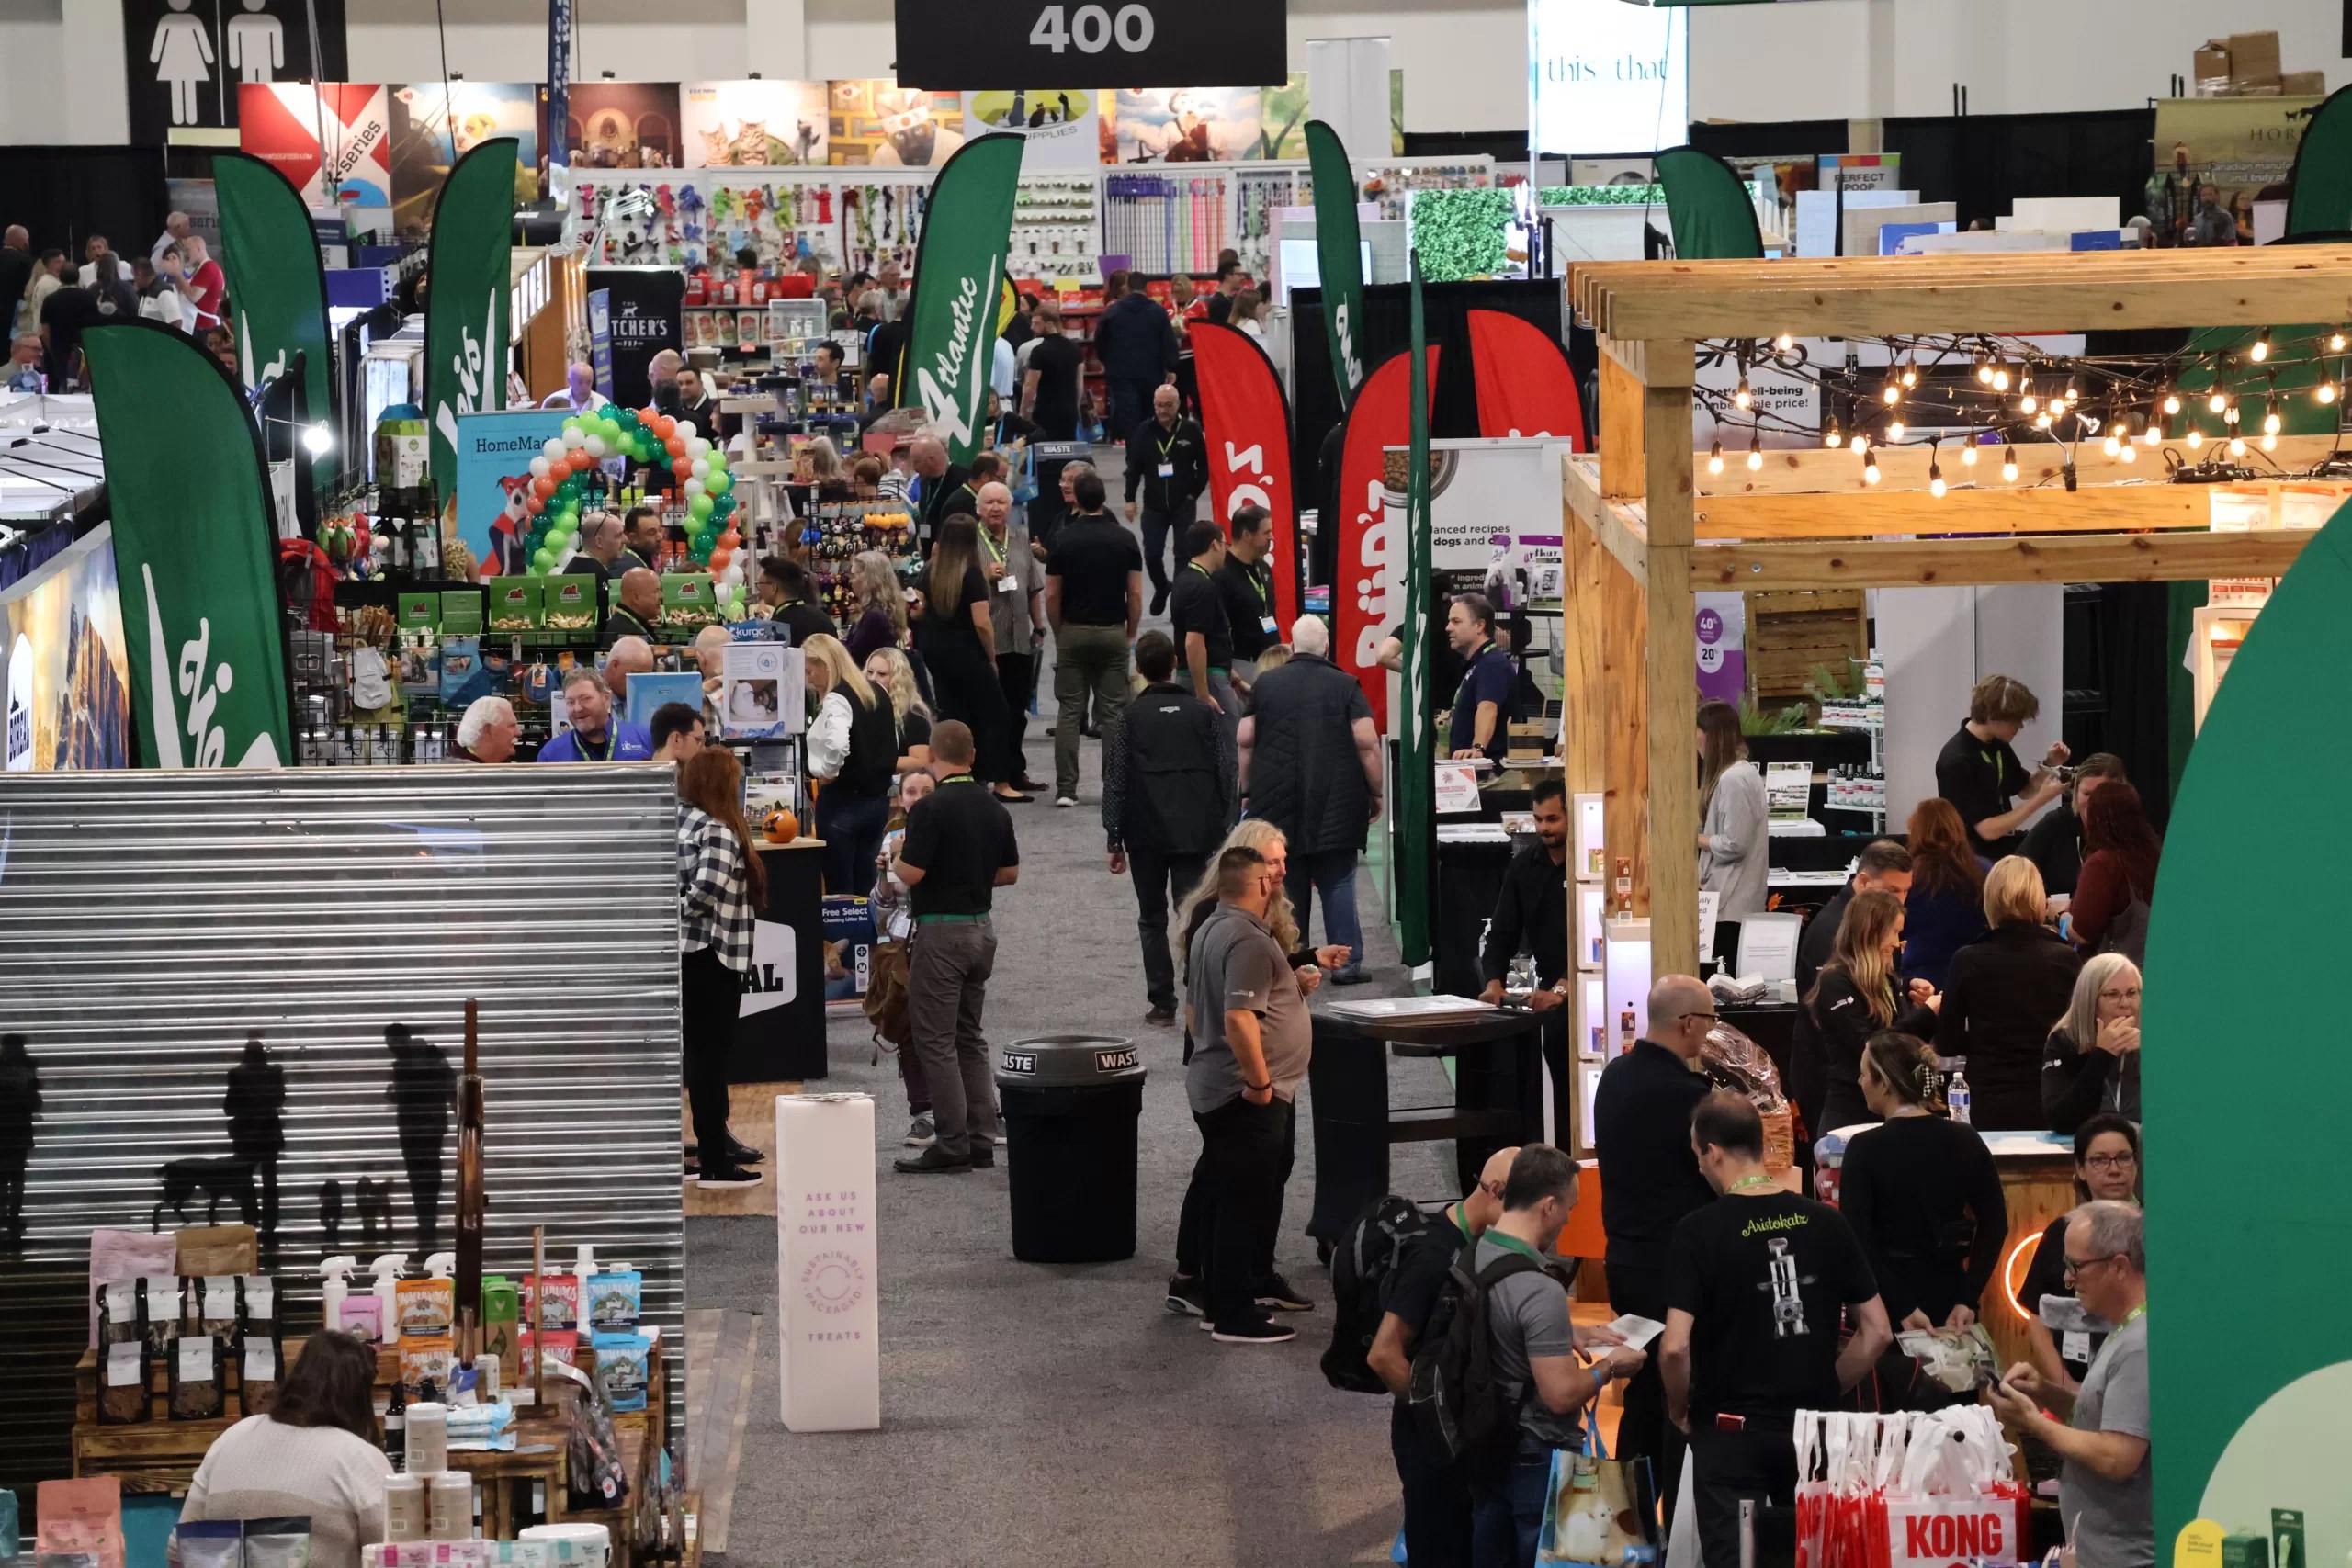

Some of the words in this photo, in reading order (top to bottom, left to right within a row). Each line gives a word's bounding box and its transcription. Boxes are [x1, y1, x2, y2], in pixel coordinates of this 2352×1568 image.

[1030, 4, 1154, 53] 400
[1549, 56, 1596, 81] this
[1616, 54, 1668, 81] that
[1023, 126, 1078, 141] UPPLIES
[1834, 173, 1884, 183] PERFECT
[1844, 183, 1875, 191] POOP
[611, 319, 668, 336] TCHER'S
[1750, 386, 1803, 396] ell-being
[1775, 398, 1808, 410] price!
[476, 436, 550, 453] HomeMa
[1470, 524, 1510, 537] recipes
[1433, 536, 1461, 547] dogs
[1464, 536, 1485, 545] and
[822, 908, 840, 917] Free
[842, 907, 868, 916] Select
[1004, 1055, 1032, 1070] ASTE
[806, 1193, 831, 1202] ASK
[840, 1192, 856, 1201] US
[808, 1207, 854, 1217] ABOUT
[799, 1224, 827, 1235] OUR
[836, 1224, 865, 1233] NEW
[1741, 1212, 1809, 1237] Aristokatz
[802, 1250, 865, 1283] SUSTAINABLY
[805, 1290, 862, 1314] PACKAGED
[808, 1331, 861, 1342] TREATS
[1906, 1513, 2004, 1558] KONG
